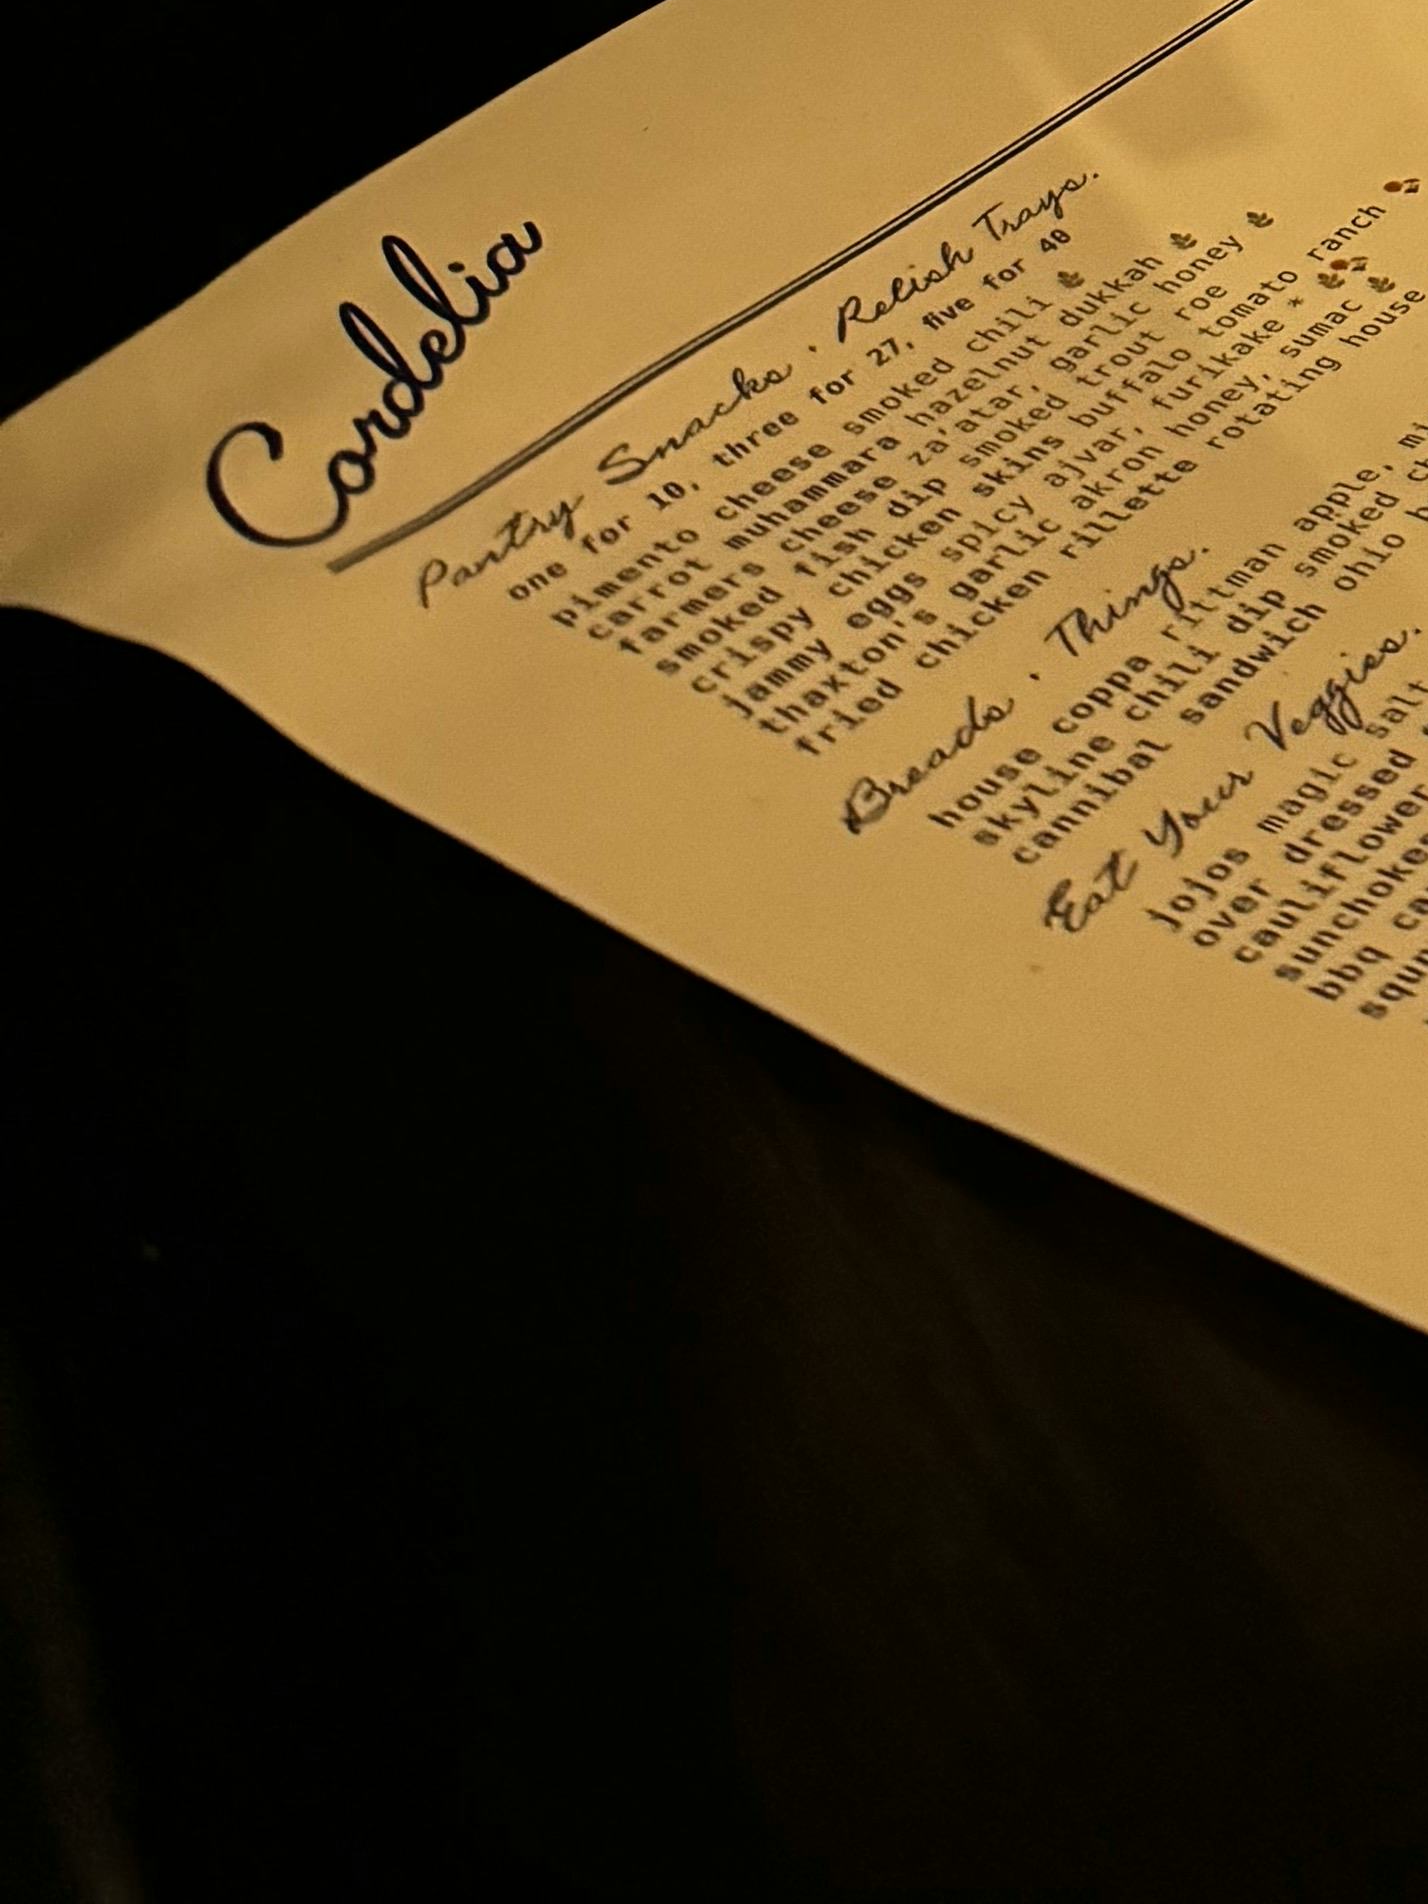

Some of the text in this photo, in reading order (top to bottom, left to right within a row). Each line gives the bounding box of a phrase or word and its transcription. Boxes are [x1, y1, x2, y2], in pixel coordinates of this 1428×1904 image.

[206, 216, 547, 550] Cordelia
[418, 173, 1099, 609] Pantry Snacks Relish Trays.
[507, 229, 1071, 601] one for 10, three for 27, five for 40
[550, 296, 1053, 628] pimento cheese smoked chili
[587, 257, 1164, 640] carrot muhammara hazelnut dukkah
[655, 285, 1228, 675] smoked fish dip smoked trout roe
[841, 547, 1209, 835] Breads Things.
[927, 748, 1042, 829] house
[1051, 656, 1152, 734] coppa
[1292, 465, 1394, 532] apple,
[972, 736, 1116, 846] skyline
[1124, 645, 1221, 722] chili
[1226, 589, 1286, 634] dip
[1293, 491, 1400, 578] smoked
[1042, 628, 1422, 933] Eat Your Veggies.
[1145, 848, 1250, 933] jojos
[1256, 753, 1358, 834] magic
